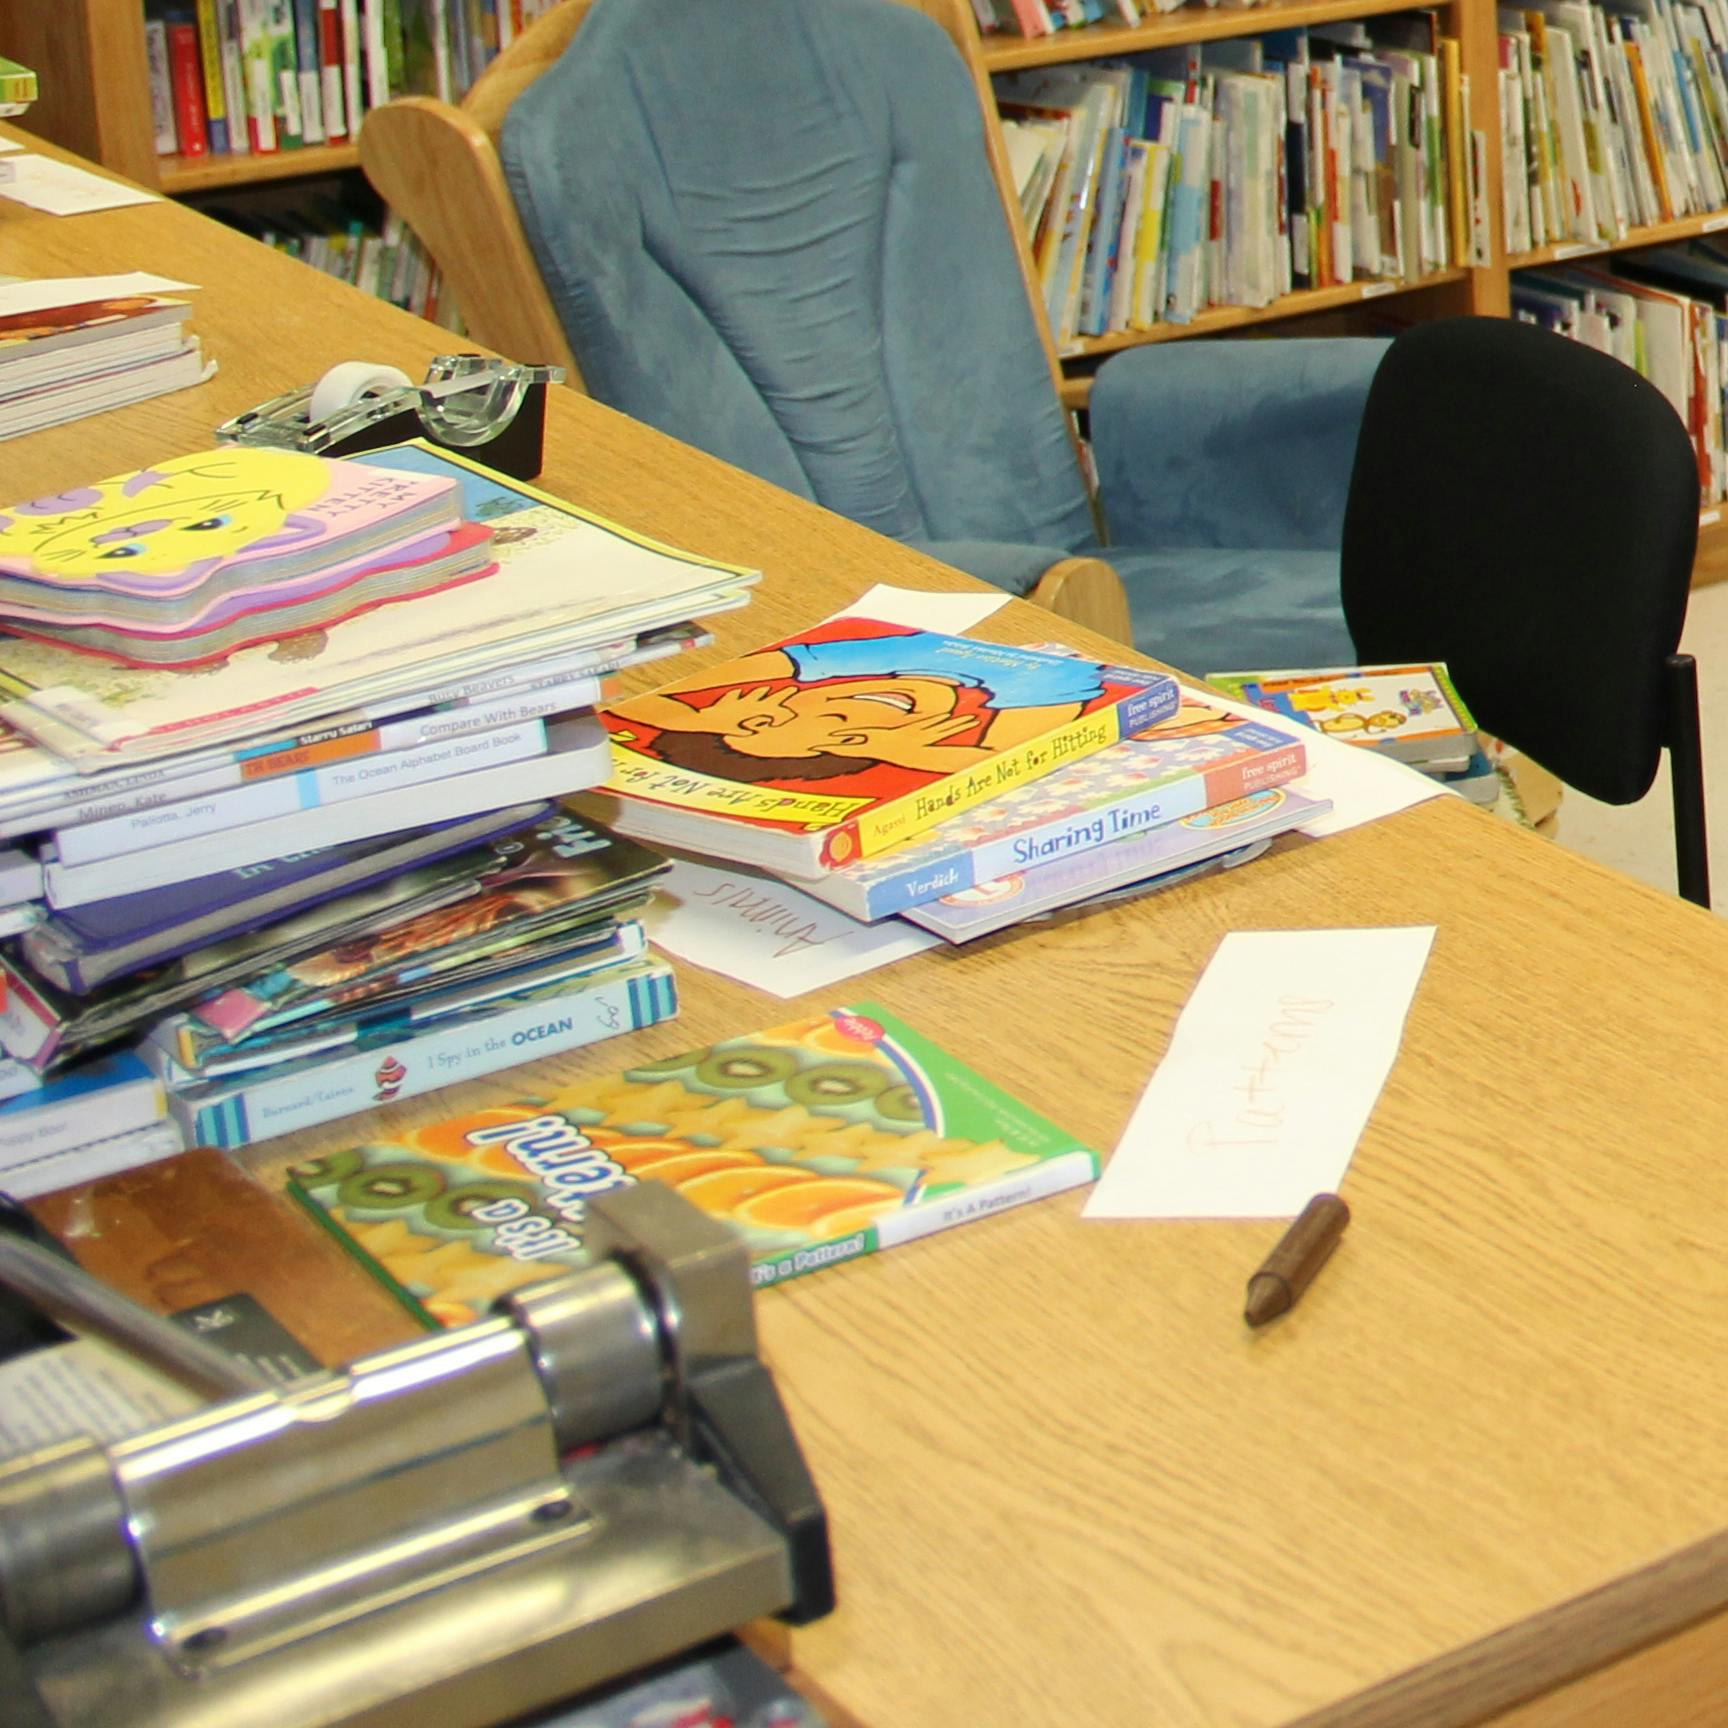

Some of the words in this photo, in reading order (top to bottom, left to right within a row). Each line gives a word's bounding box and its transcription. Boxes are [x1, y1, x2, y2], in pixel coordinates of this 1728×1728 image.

[305, 476, 395, 512] KITTEN
[420, 716, 482, 739] Compare
[484, 708, 517, 727] With
[520, 699, 558, 719] Bears
[1126, 699, 1149, 718] free
[1149, 686, 1177, 711] spirit
[332, 773, 356, 786] The
[357, 763, 399, 783] Ocean
[400, 749, 452, 771] Alphabet
[454, 740, 491, 759] Board
[492, 732, 522, 749] Book
[915, 785, 962, 821] Hands
[966, 774, 993, 800] Are
[995, 760, 1023, 785] Not
[1025, 749, 1049, 773] for
[1051, 724, 1109, 762] Hitting
[1241, 765, 1265, 781] free
[1265, 752, 1297, 773] spirit
[134, 790, 168, 810] Kate
[655, 773, 706, 796] Not
[708, 787, 757, 807] Are
[186, 801, 217, 821] Jerry
[759, 797, 856, 819] Hands
[1012, 819, 1106, 865] Sharing
[1107, 801, 1161, 834] Time
[437, 1051, 465, 1073] Spy
[466, 1045, 482, 1060] in
[484, 1036, 508, 1056] the
[511, 1017, 574, 1047] OCEAN
[943, 1208, 965, 1222] It's
[979, 1185, 1033, 1211] Pattern!
[795, 1232, 866, 1270] Pattern!
